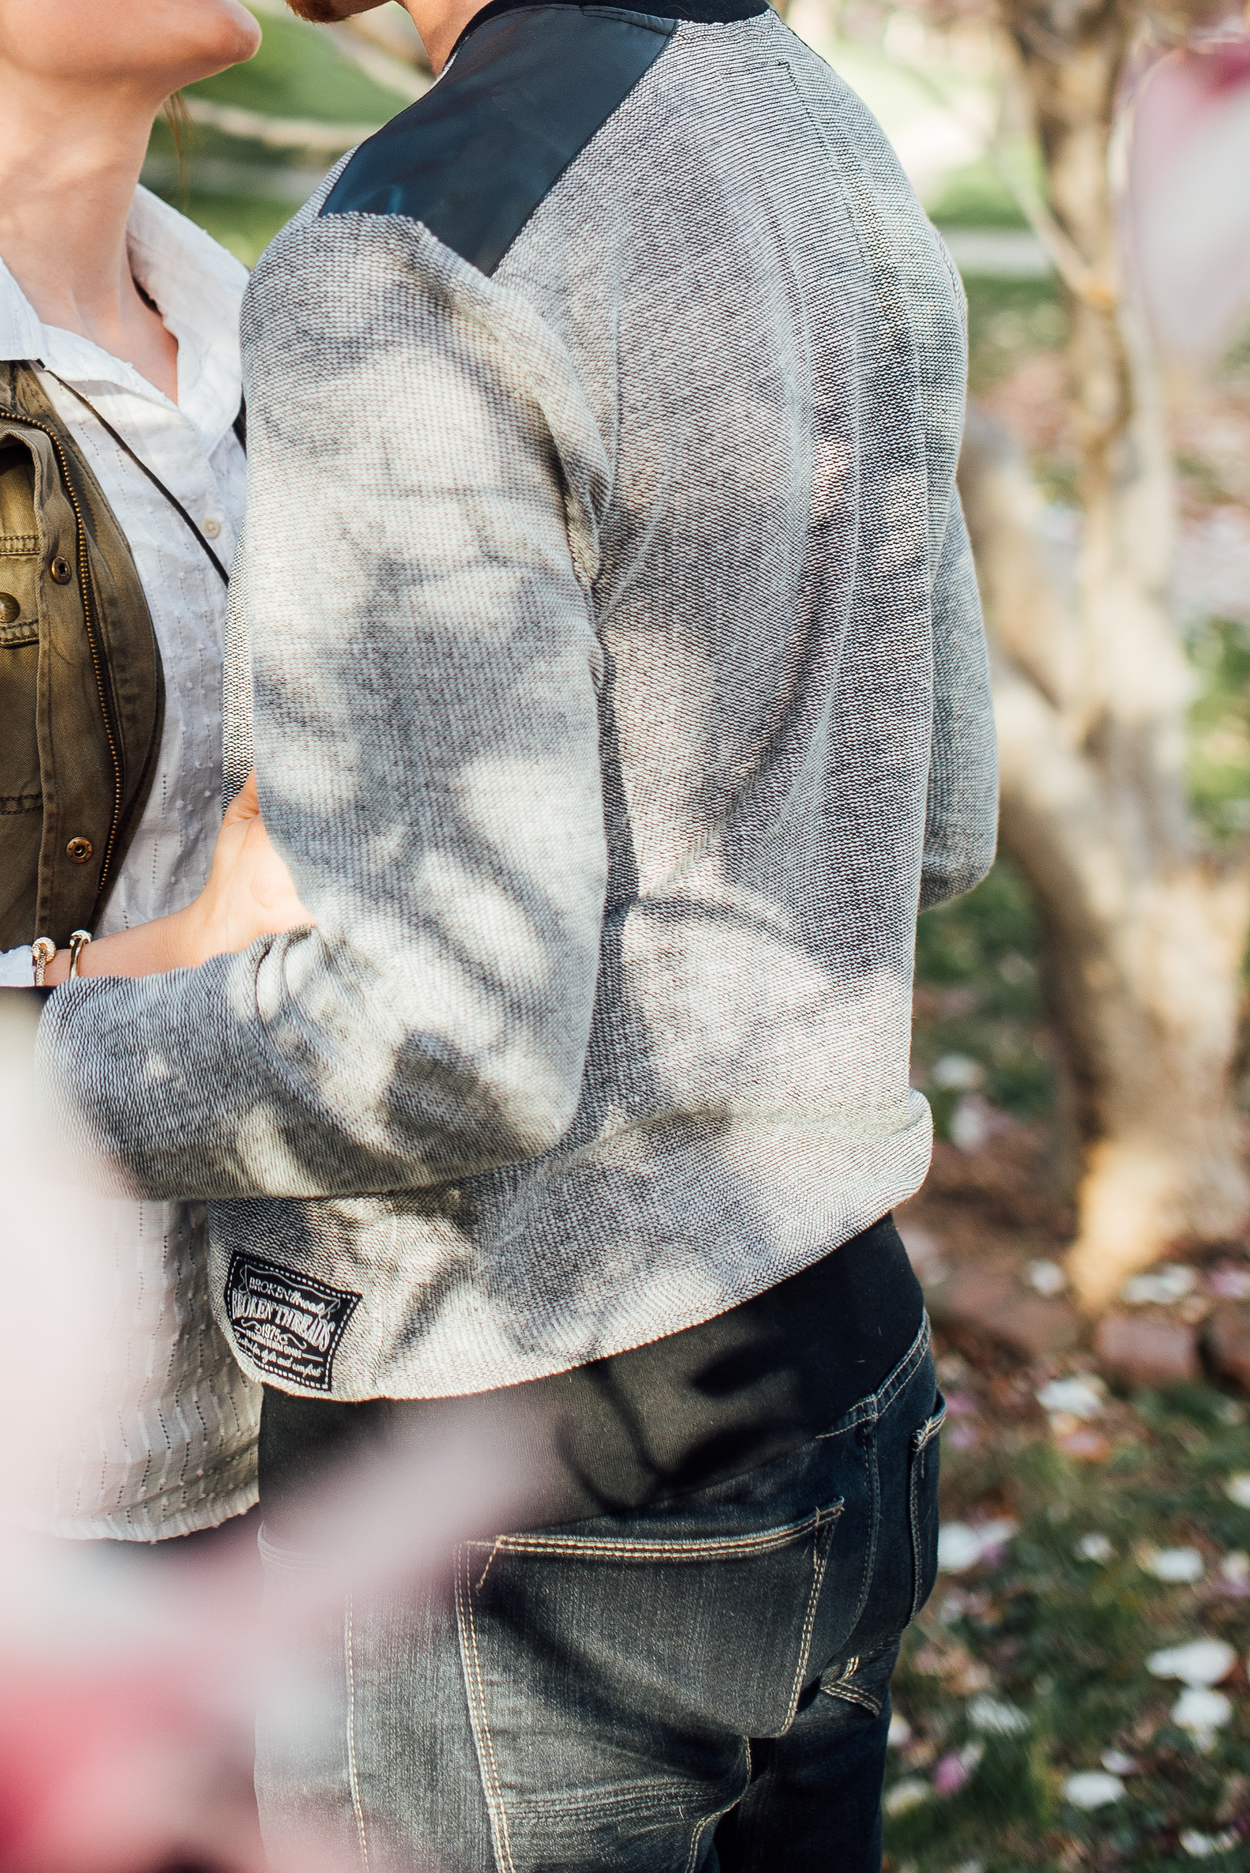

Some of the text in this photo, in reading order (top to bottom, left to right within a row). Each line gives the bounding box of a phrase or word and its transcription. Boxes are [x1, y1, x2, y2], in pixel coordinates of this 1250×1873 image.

[249, 1277, 291, 1301] BROKEN
[232, 1288, 277, 1320] BROKEN
[275, 1304, 336, 1352] THREADS
[261, 1323, 281, 1342] 1975
